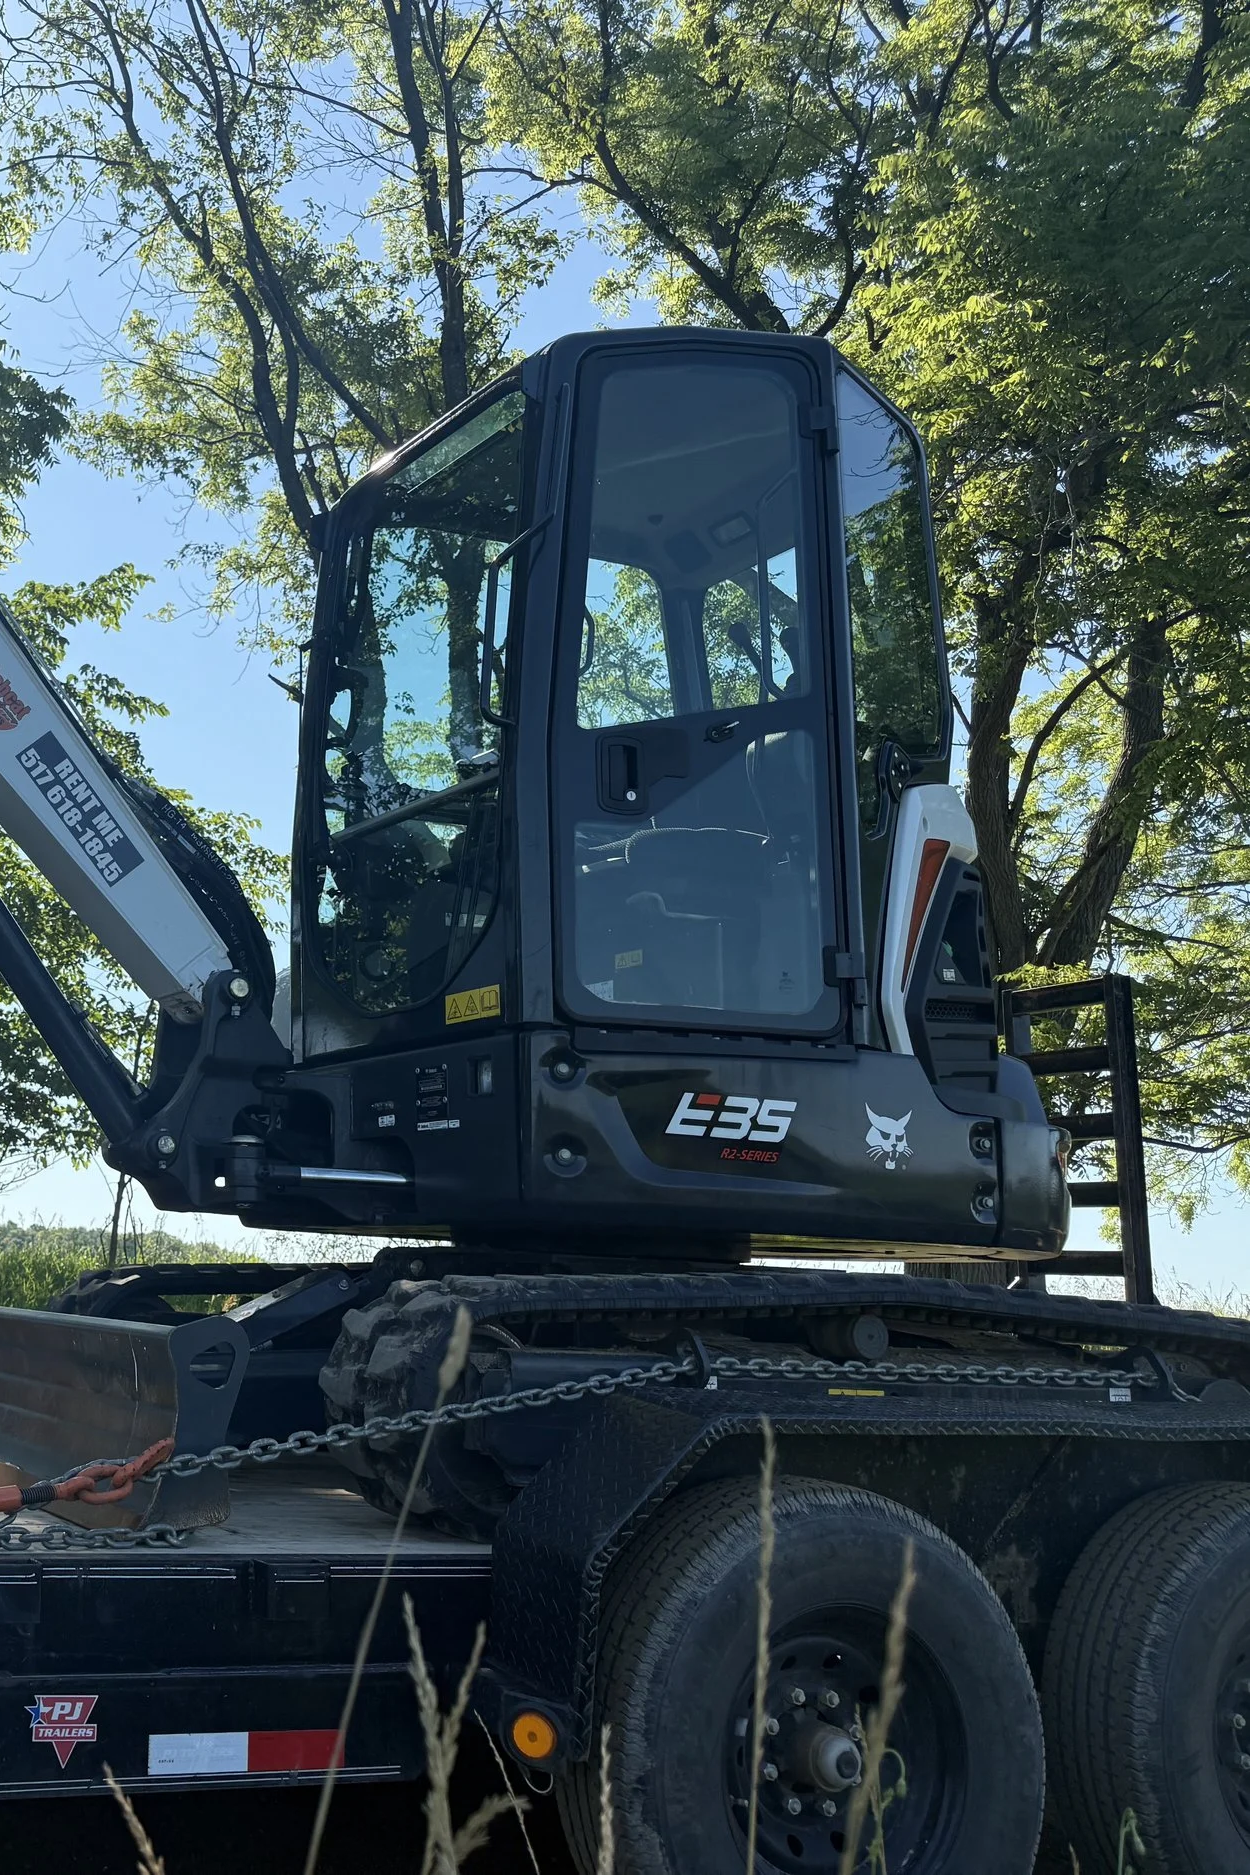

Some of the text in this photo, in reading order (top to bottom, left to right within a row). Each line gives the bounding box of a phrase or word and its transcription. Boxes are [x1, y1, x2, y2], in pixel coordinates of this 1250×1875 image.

[20, 747, 123, 882] 517 618-1845
[53, 758, 124, 848] RENT ME
[161, 803, 187, 830] HG-14
[664, 1092, 798, 1143] E35
[720, 1147, 779, 1163] R2-SERIES
[50, 1701, 83, 1720] PJ
[38, 1728, 95, 1737] TRAILERS
